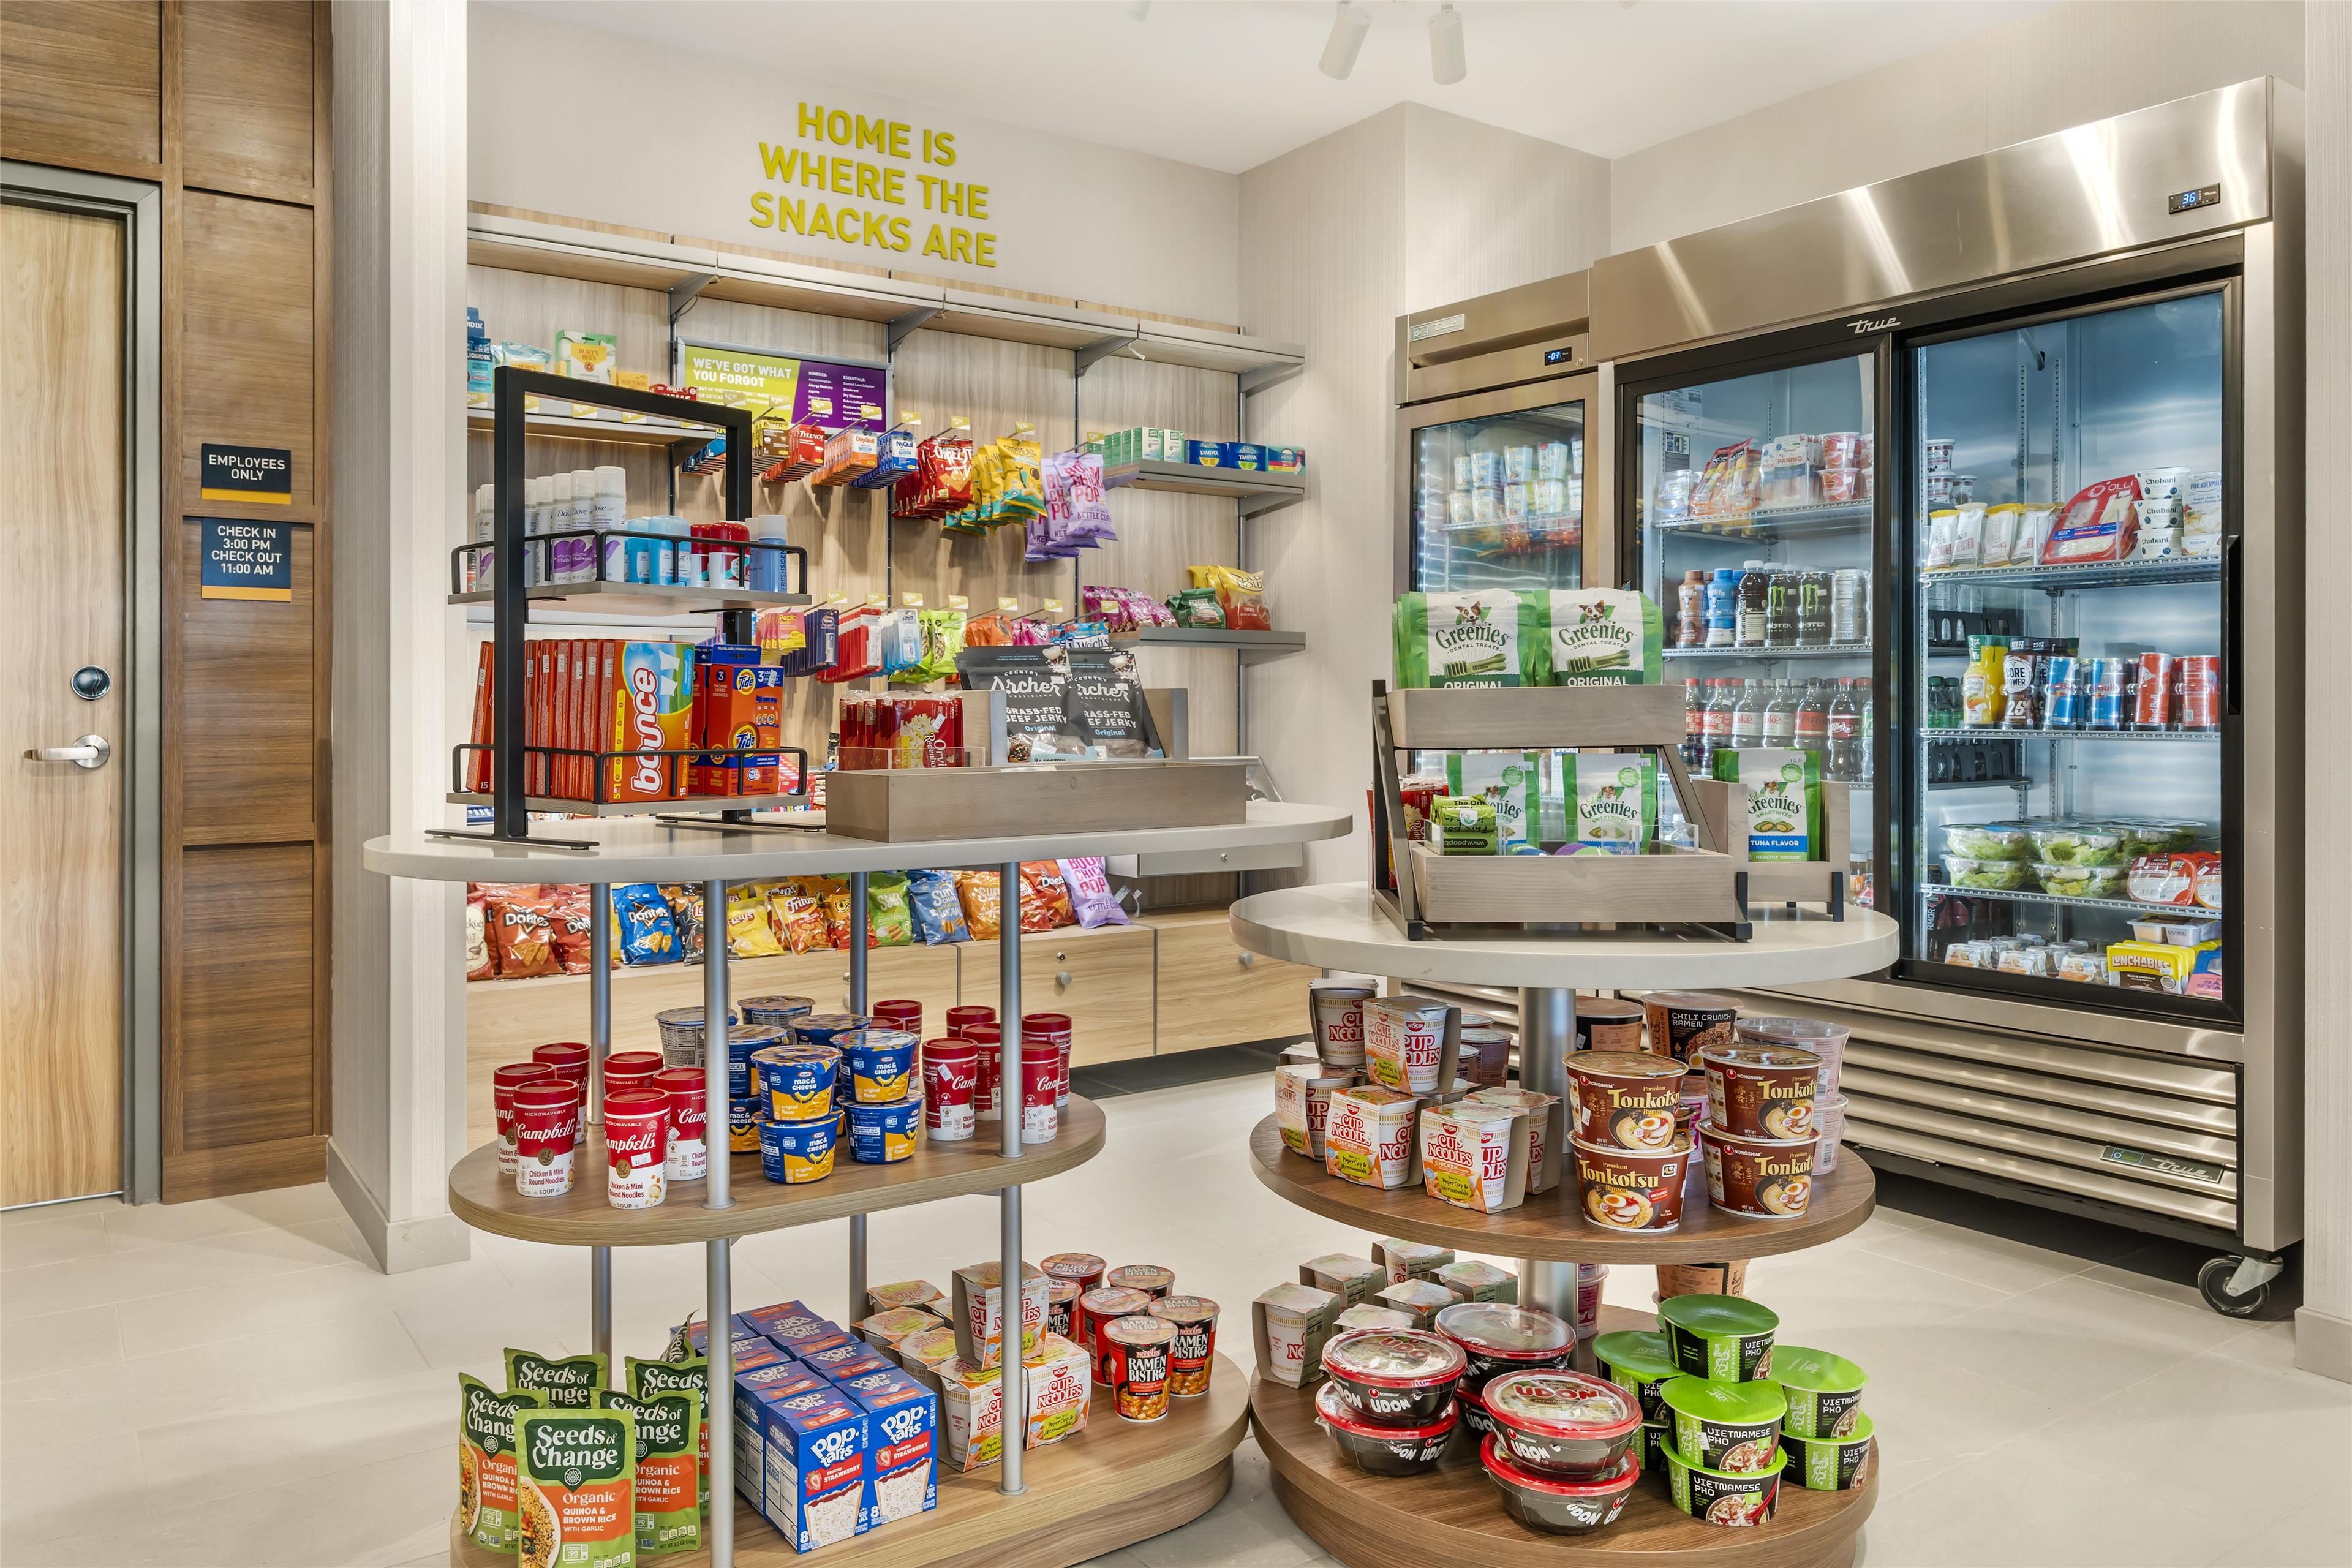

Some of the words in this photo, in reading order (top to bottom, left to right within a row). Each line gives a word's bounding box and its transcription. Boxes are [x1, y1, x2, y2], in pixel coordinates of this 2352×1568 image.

[799, 102, 911, 158] HOME
[924, 129, 957, 166] IS
[759, 142, 905, 204] WHERE
[917, 174, 989, 219] THE
[2182, 192, 2195, 205] 36
[750, 192, 911, 251] SNACKS
[922, 224, 997, 267] ARE
[693, 357, 730, 372] WE'VE
[733, 363, 756, 374] GOT
[758, 365, 792, 379] WHAT
[693, 369, 717, 382] YOU
[720, 372, 765, 387] FORGOT
[856, 435, 875, 444] DayQuil
[896, 440, 913, 449] NyQuil
[209, 454, 285, 470] EMPLOYEES
[231, 469, 263, 480] ONLY
[2108, 480, 2133, 491] OLLI
[1075, 485, 1099, 502] POP
[217, 526, 260, 538] CHECK
[263, 528, 276, 538] IN
[223, 538, 248, 549] 3:00
[252, 540, 270, 550] PM
[211, 550, 254, 562] CHECK
[257, 553, 282, 563] OUT
[221, 563, 251, 574] 11:00
[254, 565, 273, 575] AM
[1435, 624, 1511, 649] Greenies
[1558, 621, 1637, 647] Greenies
[1573, 641, 1598, 650] DENTAL
[1600, 639, 1625, 649] TREATS
[718, 671, 724, 680] 3
[2007, 667, 2026, 679] CORE
[739, 675, 754, 690] Tide
[2007, 678, 2026, 687] POWER
[1006, 706, 1062, 715] GRASS-FED
[1035, 714, 1067, 724] JERKY
[1104, 718, 1136, 728] JERKY
[631, 667, 665, 794] bounce
[736, 733, 755, 750] Tide
[680, 787, 686, 796] 15
[1580, 800, 1638, 820] Greenies
[787, 897, 815, 911] Fritos
[628, 908, 668, 924] Doritos
[2112, 956, 2171, 970] LUNCHABLES
[1702, 1012, 1731, 1022] CRUNCH
[1588, 1080, 1613, 1088] NONGSHIM
[1607, 1088, 1680, 1108] Tonkotsu
[516, 1118, 576, 1143] Campbell's
[1428, 1142, 1473, 1167] NOODLES
[1579, 1160, 1659, 1188] Tonkotsu
[1128, 1355, 1166, 1370] RAMEN
[1129, 1366, 1166, 1382] BISTRO
[1049, 1376, 1074, 1393] CUP
[1037, 1384, 1083, 1409] NOODLES
[1370, 1398, 1411, 1412] UDON
[536, 1425, 606, 1447] Seeds
[606, 1433, 617, 1444] of
[1707, 1427, 1770, 1438] VIETNAMESE
[1708, 1436, 1729, 1446] PHO
[532, 1442, 618, 1469] Change
[820, 1444, 853, 1468] tarts
[894, 1441, 928, 1460] STRAWBERRY
[824, 1464, 860, 1482] STRAWBERRY
[1694, 1476, 1760, 1491] VIETNAMESE
[563, 1491, 616, 1505] Organic
[564, 1515, 597, 1524] BROWN
[598, 1513, 616, 1523] RICE
